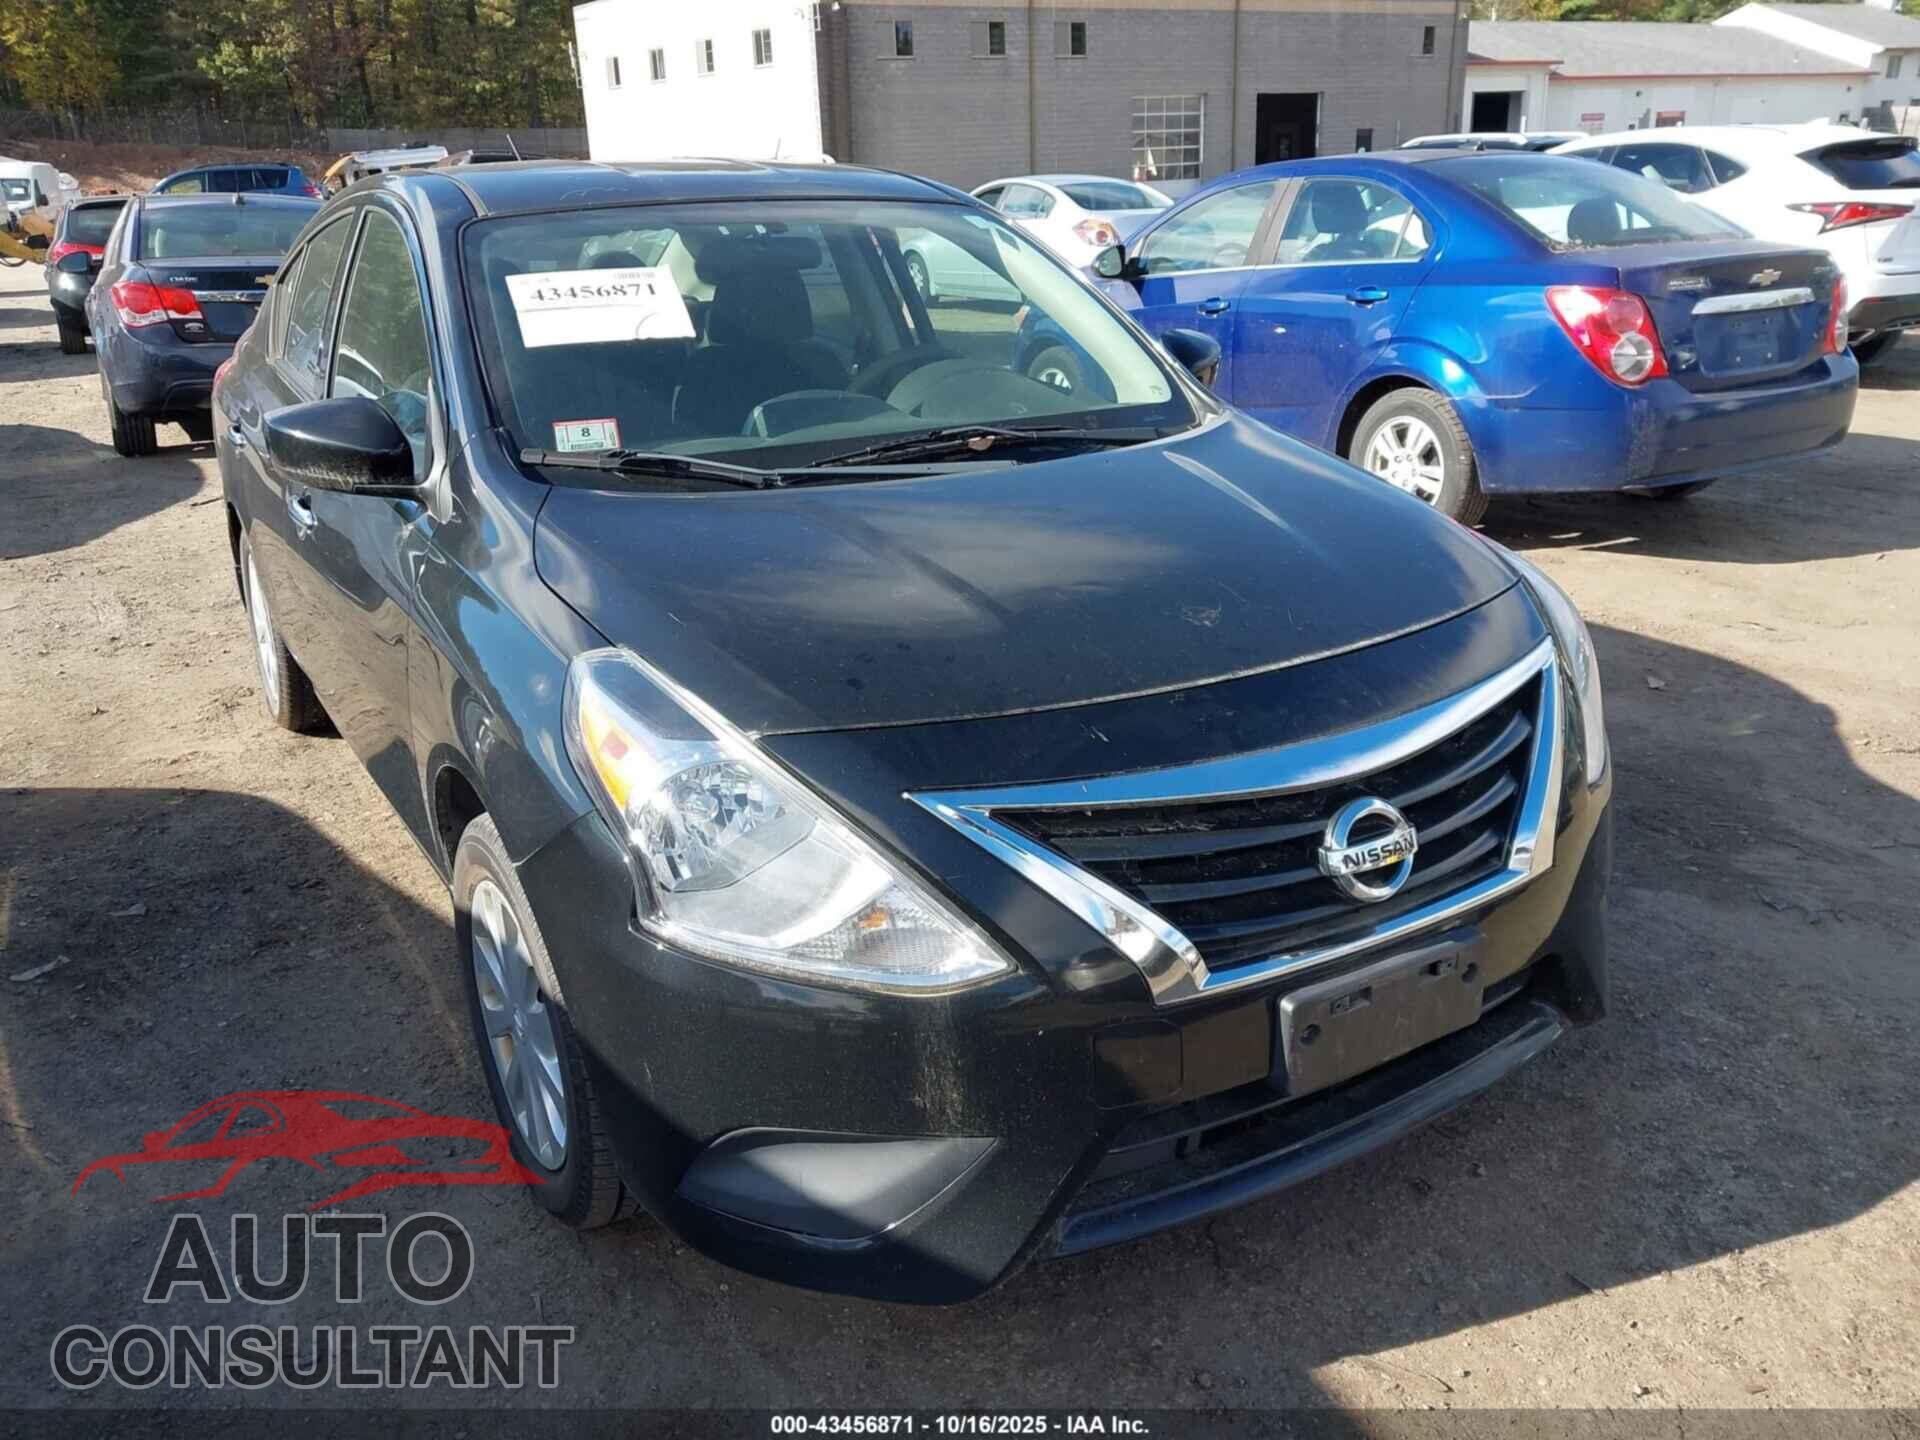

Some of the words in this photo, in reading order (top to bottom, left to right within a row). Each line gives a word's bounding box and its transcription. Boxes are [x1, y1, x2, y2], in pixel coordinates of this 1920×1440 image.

[530, 282, 657, 302] 43456871
[581, 427, 591, 437] 8
[1342, 833, 1415, 869] NISSAN
